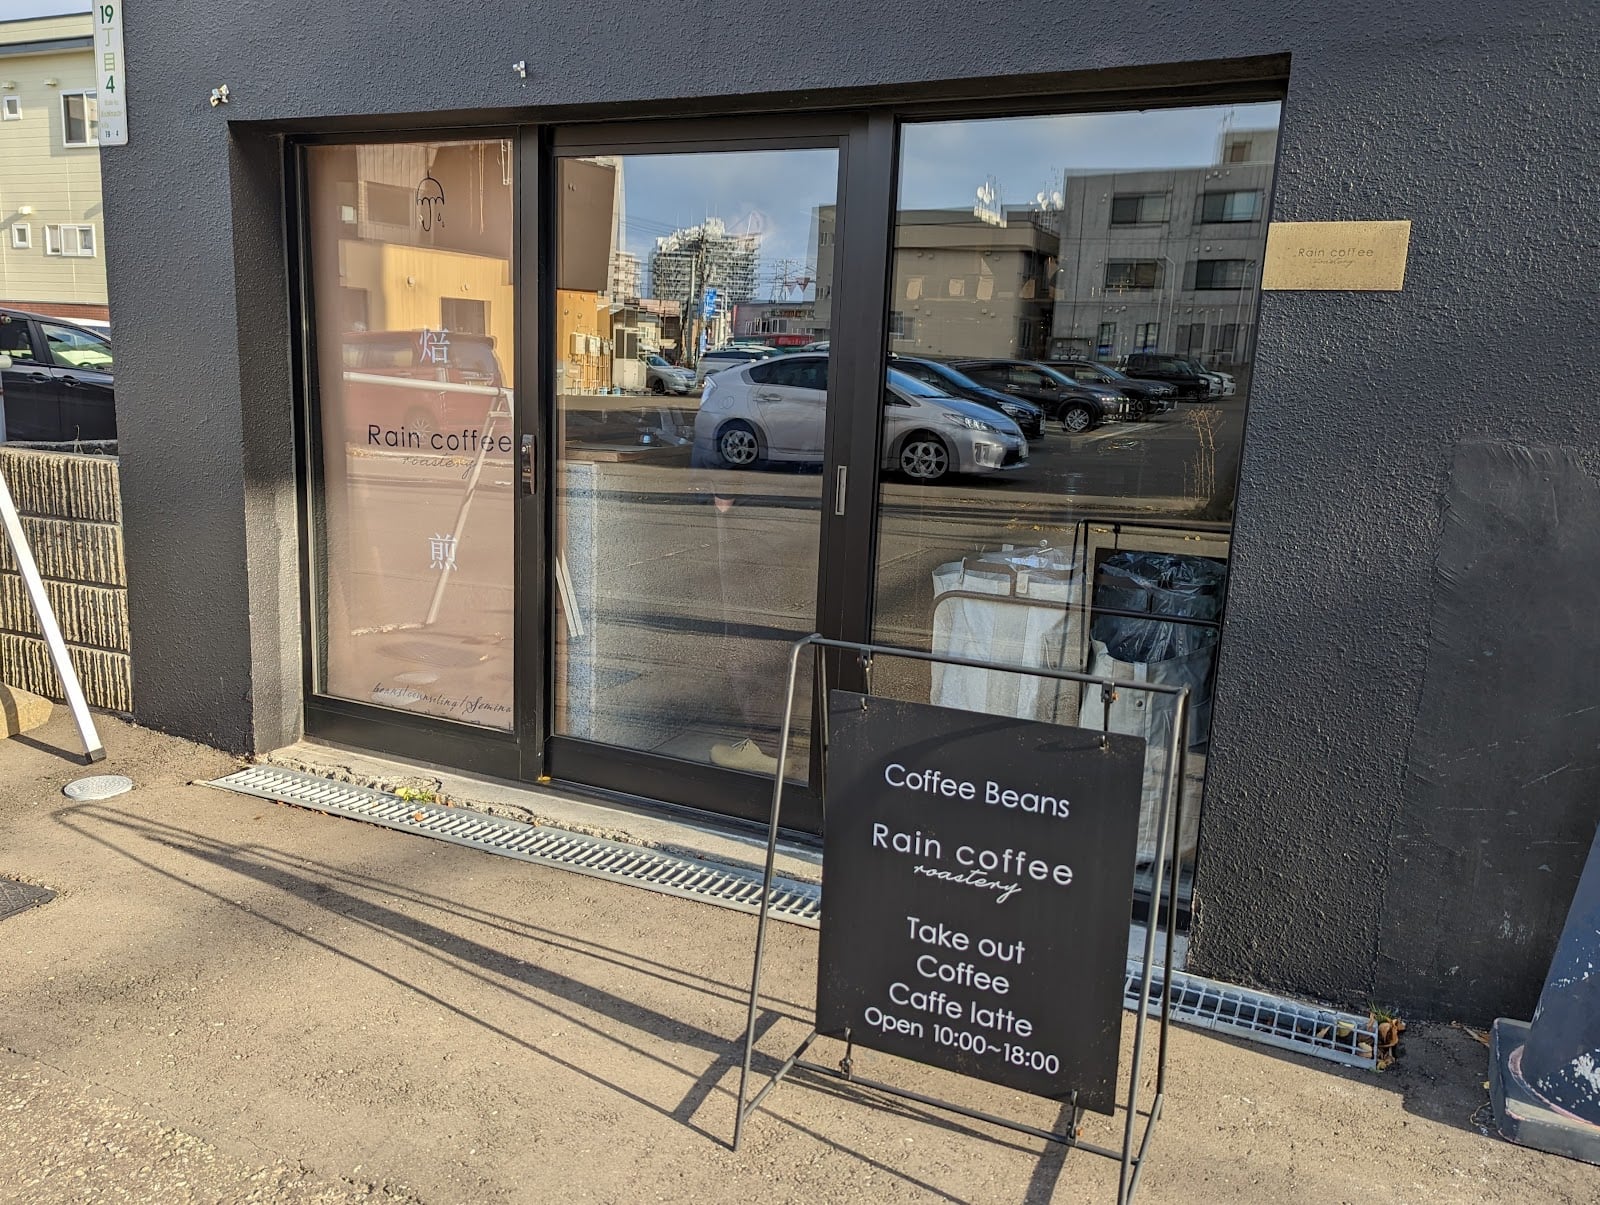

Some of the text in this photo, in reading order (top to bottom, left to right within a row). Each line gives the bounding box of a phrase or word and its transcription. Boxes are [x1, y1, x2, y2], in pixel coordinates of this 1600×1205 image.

[1298, 247, 1374, 257] Rain coffee
[419, 328, 450, 364] 焙
[368, 424, 512, 452] Rain coffee
[402, 453, 476, 479] roastery
[428, 532, 457, 571] 煎
[884, 763, 1070, 818] Coffee Beans
[872, 823, 1073, 885] Rain coffee
[913, 864, 1022, 904] roastery
[906, 916, 1025, 964] Take out
[916, 954, 1010, 994] Coffee
[889, 982, 1033, 1037] Caffe latte
[864, 1007, 1060, 1074] Open 10:00~18:00
